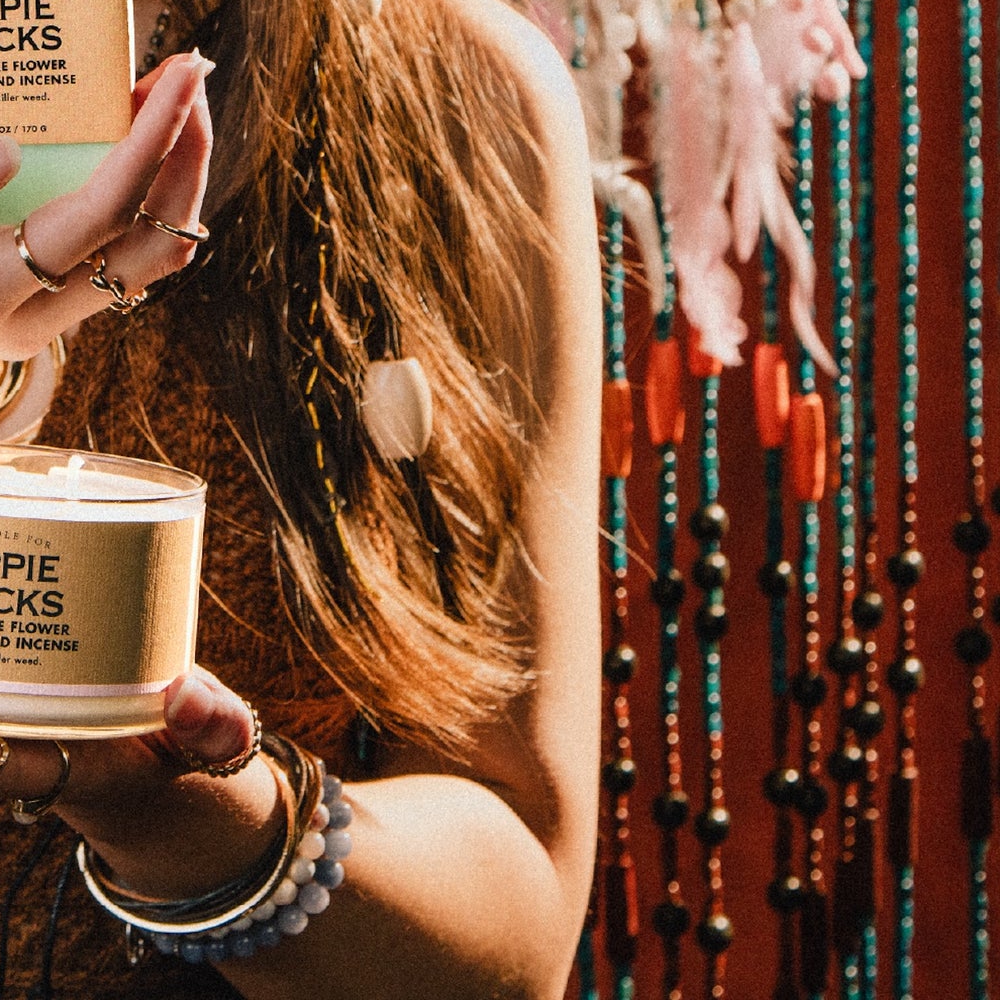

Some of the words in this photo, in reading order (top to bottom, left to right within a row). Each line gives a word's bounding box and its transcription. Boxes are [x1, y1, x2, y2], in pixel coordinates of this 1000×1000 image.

[13, 59, 67, 71] FLOWER
[20, 74, 76, 85] INCENSE
[22, 92, 50, 101] weed.
[22, 125, 37, 133] 170
[27, 535, 52, 549] FOR
[11, 621, 70, 635] FLOWER
[16, 637, 79, 651] INCENSE
[14, 657, 42, 666] weed.
